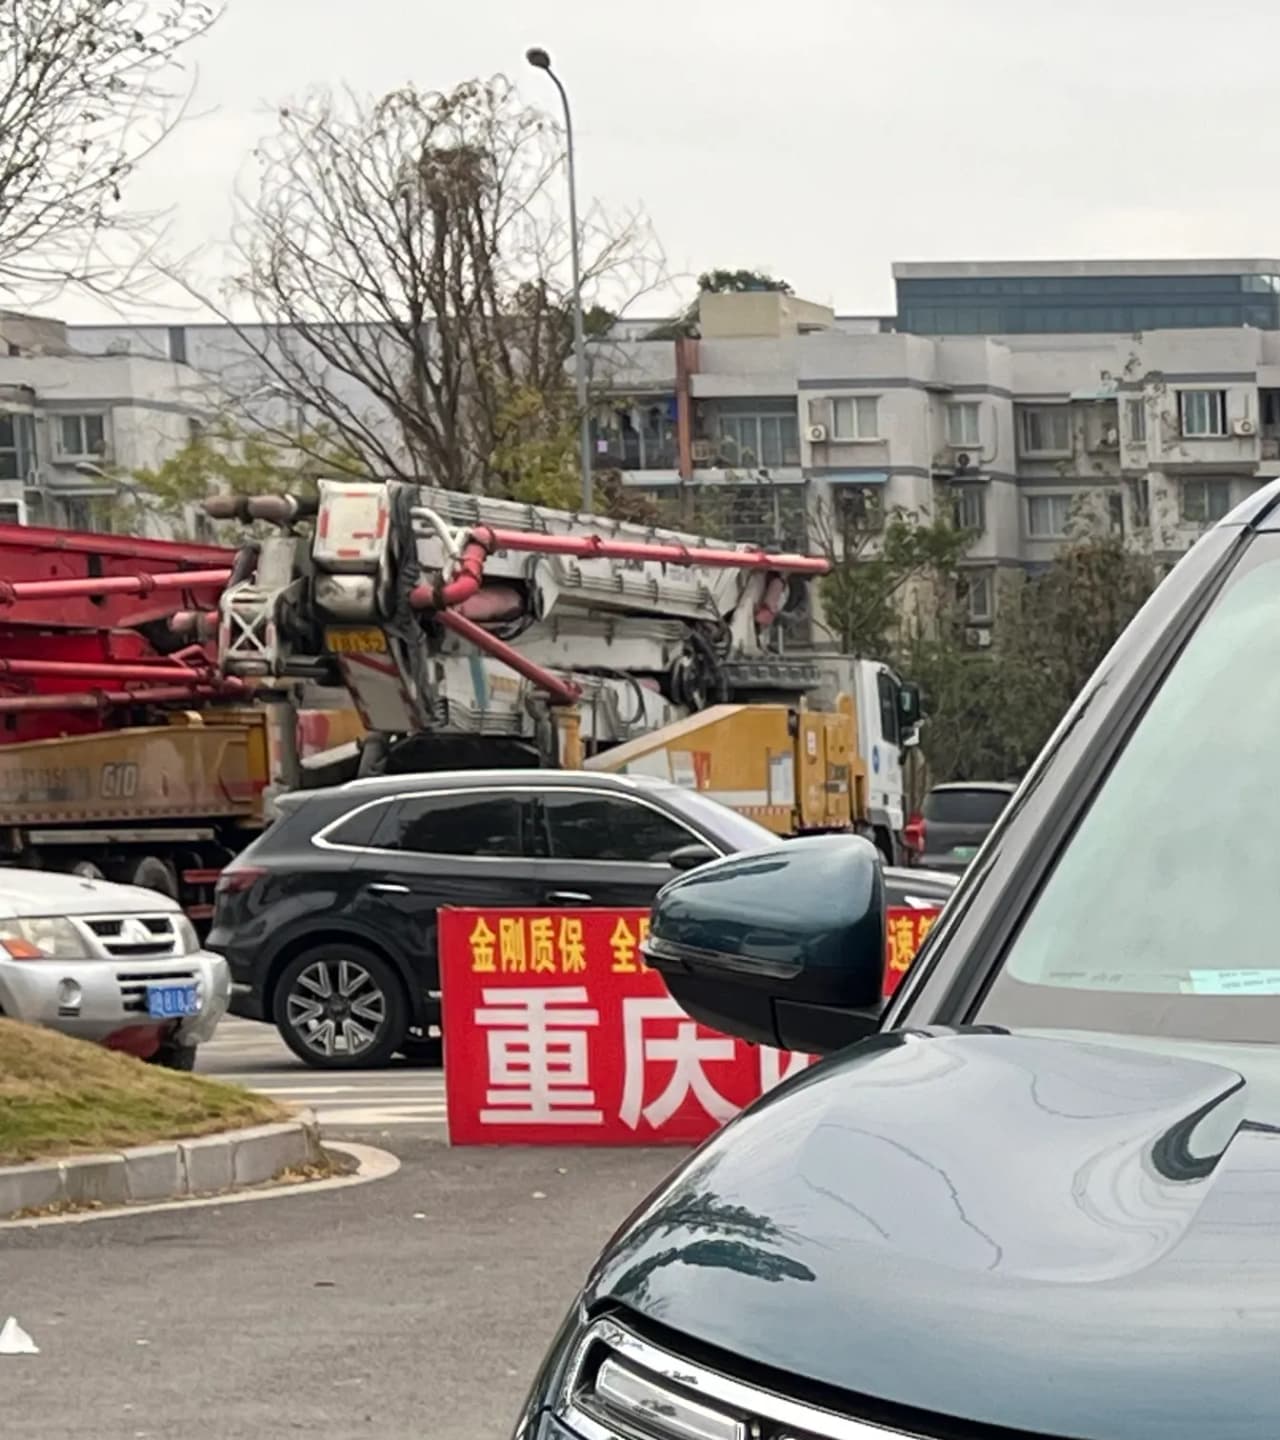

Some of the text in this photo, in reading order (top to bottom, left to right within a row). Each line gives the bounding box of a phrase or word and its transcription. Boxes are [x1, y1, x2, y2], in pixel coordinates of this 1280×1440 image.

[469, 916, 586, 973] 金刚质保
[474, 986, 810, 1131] 重庆
